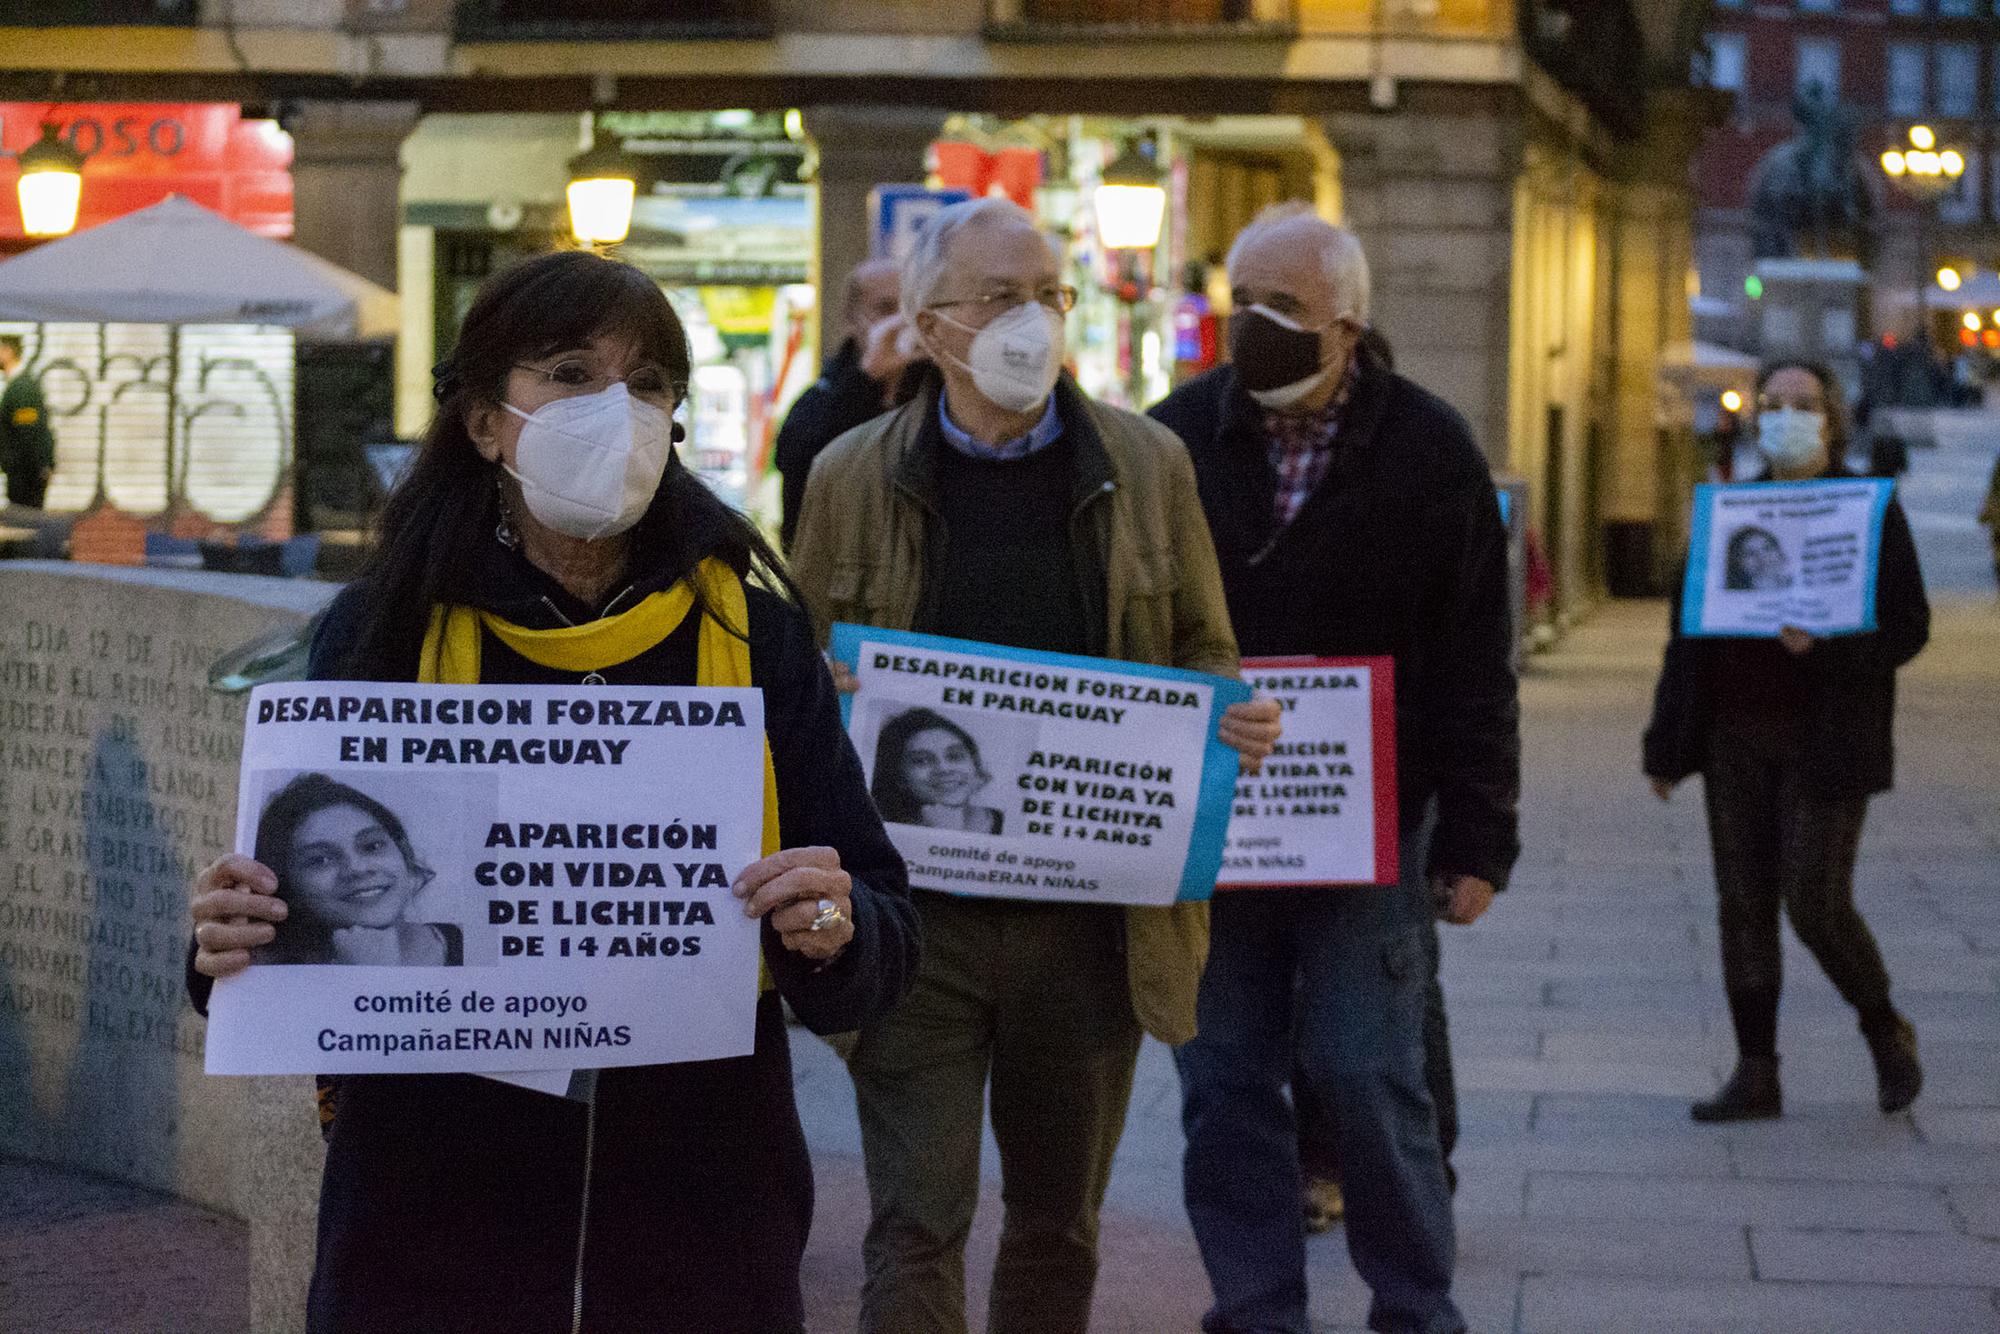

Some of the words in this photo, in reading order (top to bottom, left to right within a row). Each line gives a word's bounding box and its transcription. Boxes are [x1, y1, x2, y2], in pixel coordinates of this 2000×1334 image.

[127, 633, 153, 664] DE
[71, 667, 99, 700] EL
[873, 652, 1068, 693] DESAPARICION
[1076, 677, 1200, 709] FORZADA
[1253, 675, 1359, 690] FORZADA
[257, 696, 532, 724] DESAPARICION
[547, 699, 746, 726] FORZADA
[942, 687, 975, 706] EN
[983, 691, 1126, 724] PARAGUAY
[112, 715, 140, 745] DE
[340, 736, 388, 763] EN
[402, 737, 632, 765] PARAGUAY
[1027, 751, 1173, 783] APARICIÓN
[1266, 763, 1319, 778] VIDA
[1323, 762, 1354, 777] YA
[1017, 773, 1068, 794] CON
[1075, 780, 1135, 803] VIDA
[1143, 788, 1176, 808] YA
[1260, 783, 1346, 799] LICHITA
[1022, 798, 1055, 816] DE
[1062, 802, 1163, 830] LICHITA
[1235, 803, 1256, 817] DE
[484, 818, 717, 850] APARICIÓN
[1027, 821, 1054, 835] DE
[1063, 825, 1088, 839] 14
[1093, 827, 1153, 847] AÑOS
[929, 844, 992, 862] comité
[996, 849, 1018, 865] de
[1023, 854, 1076, 871] apoyo
[14, 863, 43, 896] EL
[474, 861, 554, 887] CON
[563, 862, 666, 888] VIDA
[672, 863, 729, 888] YA
[1042, 873, 1100, 891] NIÑAS
[488, 900, 539, 925] DE
[552, 900, 715, 926] LICHITA
[502, 935, 544, 957] DE
[560, 936, 599, 957] 14
[607, 932, 702, 957] AÑOS
[353, 989, 451, 1013] comité
[461, 991, 495, 1013] de
[504, 996, 588, 1018] apoyo
[317, 1028, 533, 1056] CampañaERAN
[543, 1021, 632, 1049] NIÑAS
